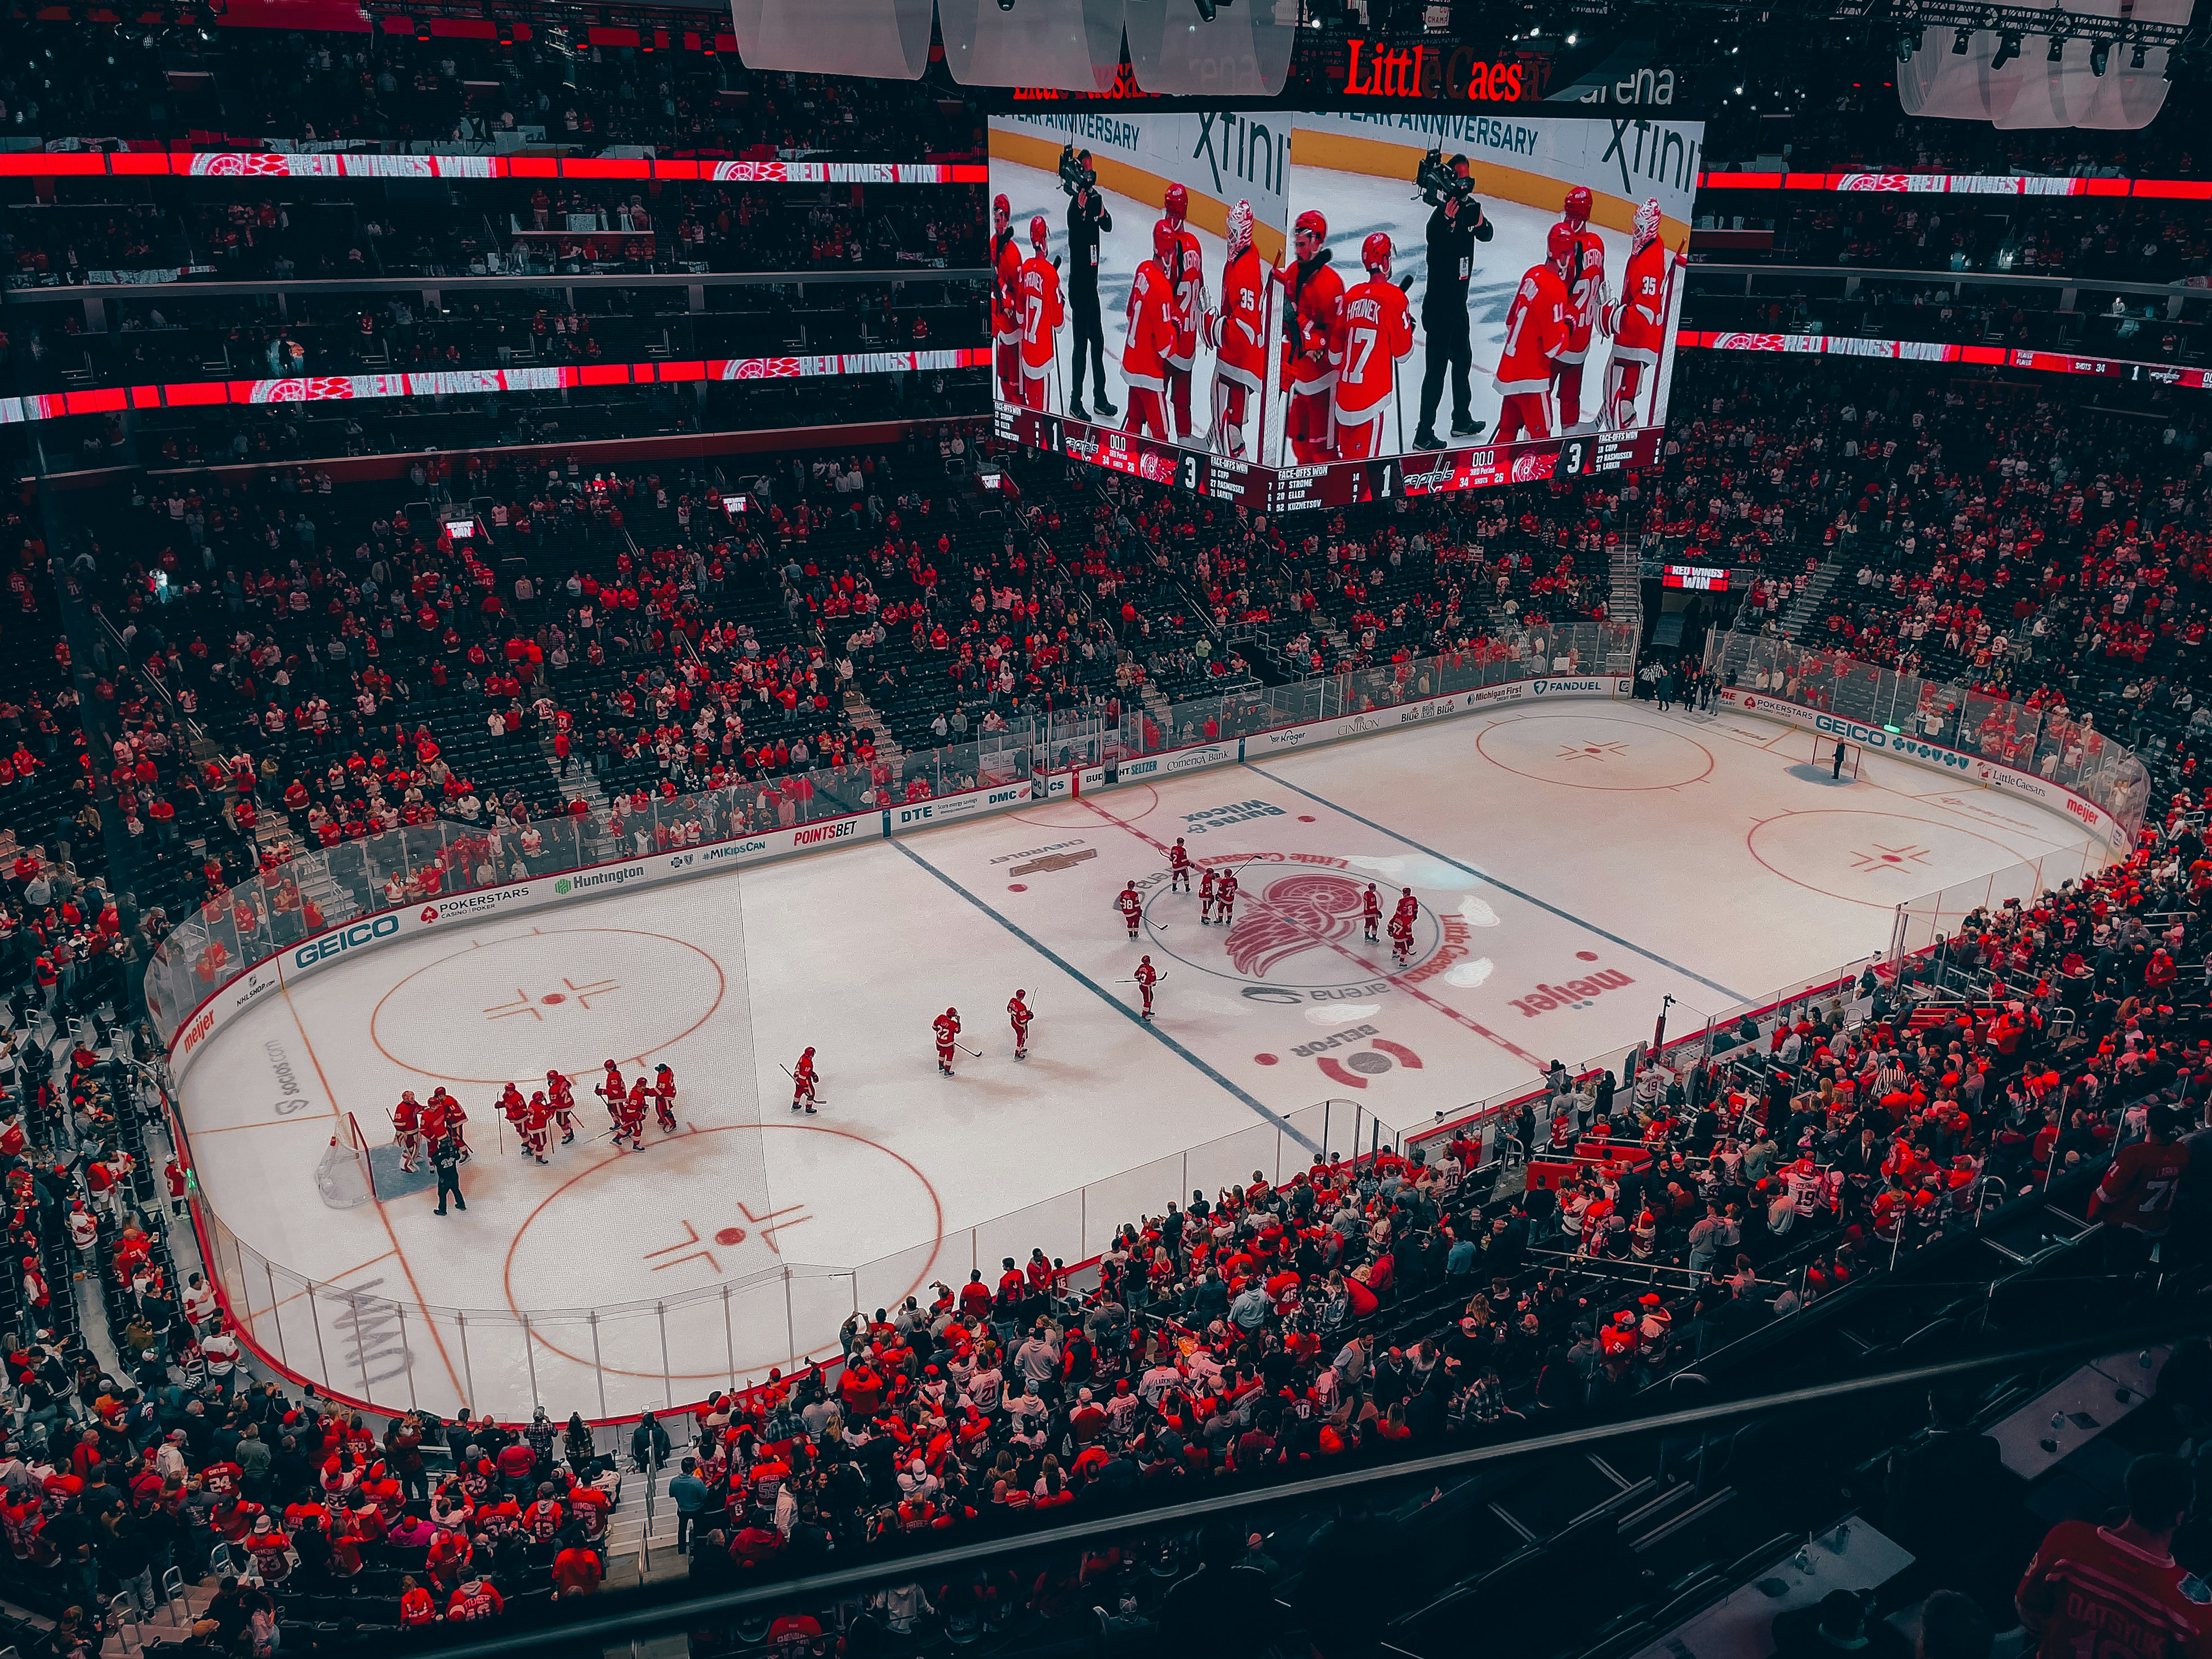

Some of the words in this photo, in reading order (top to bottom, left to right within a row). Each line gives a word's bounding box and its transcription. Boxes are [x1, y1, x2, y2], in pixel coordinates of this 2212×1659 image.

[1343, 39, 1442, 99] Little
[1045, 114, 1140, 152] ANNIVERSARY
[1398, 115, 1538, 157] ANNIVERSARY
[786, 163, 824, 182] RED
[828, 163, 893, 183] WINGS
[897, 164, 936, 183] WIN
[1950, 176, 2019, 194] WINGS
[1641, 276, 1656, 296] 35
[1239, 287, 1254, 311] 35
[1025, 291, 1042, 344] 17
[1342, 326, 1377, 384] 17
[1784, 335, 1821, 354] RED
[1827, 336, 1894, 357] WINGS
[799, 356, 837, 376] RED
[843, 352, 910, 374] WINGS
[915, 350, 956, 370] WIN
[2095, 363, 2106, 373] 34
[2131, 366, 2139, 380] 1
[1052, 422, 1058, 451] 1
[1110, 434, 1126, 451] 00.0
[1599, 432, 1626, 444] FACE-OFFS
[1626, 430, 1639, 441] WON
[1596, 455, 1603, 464] 27
[1604, 451, 1633, 462] RASMUSSEN
[1605, 444, 1618, 453] COPP
[1102, 455, 1110, 465] 34
[1127, 461, 1134, 472] 26
[1211, 456, 1236, 471] FACE-OFFS
[1236, 462, 1248, 474] WON
[1472, 450, 1494, 467] 00.0
[1567, 443, 1582, 474] 3
[1185, 456, 1196, 489] 3
[1278, 468, 1312, 479] FACE-OFFS
[1312, 465, 1328, 476] WON
[1353, 473, 1359, 482] 14
[1404, 459, 1456, 491] capitals
[1480, 466, 1496, 475] Period
[1278, 482, 1284, 490] 17
[1288, 479, 1314, 489] STROME
[1381, 465, 1391, 497] 1
[1459, 477, 1469, 488] 34
[1494, 473, 1504, 483] 26
[1276, 492, 1285, 501] 20
[1288, 490, 1305, 500] ELLER
[725, 502, 745, 513] WIN
[1276, 503, 1284, 513] 92
[1288, 499, 1322, 512] KUZNETSOV
[451, 527, 471, 537] WIN
[1672, 565, 1690, 577] RED
[1691, 567, 1724, 579] WINGS
[1682, 576, 1711, 590] WIN
[1475, 688, 1505, 701] Michigan
[1506, 685, 1522, 696] First
[1550, 680, 1602, 692] FANDUEL
[1401, 711, 1419, 723] Blue
[1436, 704, 1455, 715] Blue
[1757, 699, 1813, 720] POKERSTARS
[1337, 718, 1381, 736] CINTRON
[1815, 714, 1887, 748] GEICO
[1280, 730, 1306, 745] Kroger
[1208, 749, 1230, 763] Bank
[1085, 771, 1103, 784] BUD
[1131, 760, 1158, 775] SELTZER
[1993, 770, 2015, 785] Little
[2015, 777, 2046, 798] Caesars
[988, 790, 1017, 804] DMC
[901, 806, 933, 823] DTE
[1178, 799, 1272, 822] Wilcox
[1206, 806, 1287, 828] Burns
[2067, 797, 2099, 825] meijer
[794, 820, 858, 846] POINTSBET
[990, 838, 1086, 865] CHEVROLET
[1198, 852, 1287, 866] Caesars
[1289, 852, 1350, 869] Little
[573, 865, 644, 889] Huntington
[439, 886, 530, 912] POKERSTARS
[440, 908, 468, 919] CASINO
[471, 902, 496, 913] POKER
[1439, 913, 1472, 944] Little
[295, 914, 399, 969] GEICO
[1403, 944, 1470, 983] Caesars
[1310, 981, 1392, 1001] arena
[1508, 968, 1637, 1019] meijer
[184, 1009, 216, 1055] meijer
[936, 1025, 950, 1040] 22
[1290, 1024, 1381, 1058] BELFOR
[1646, 1080, 1658, 1093] 19
[1795, 1190, 1816, 1207] 19
[2139, 1179, 2179, 1212] 71
[1056, 1277, 1067, 1288] 16
[1612, 1341, 1625, 1354] 53
[981, 1385, 997, 1403] 21
[208, 1475, 232, 1493] 24
[759, 1481, 780, 1499] 59
[535, 1522, 554, 1538] 13
[259, 1555, 281, 1572] 23
